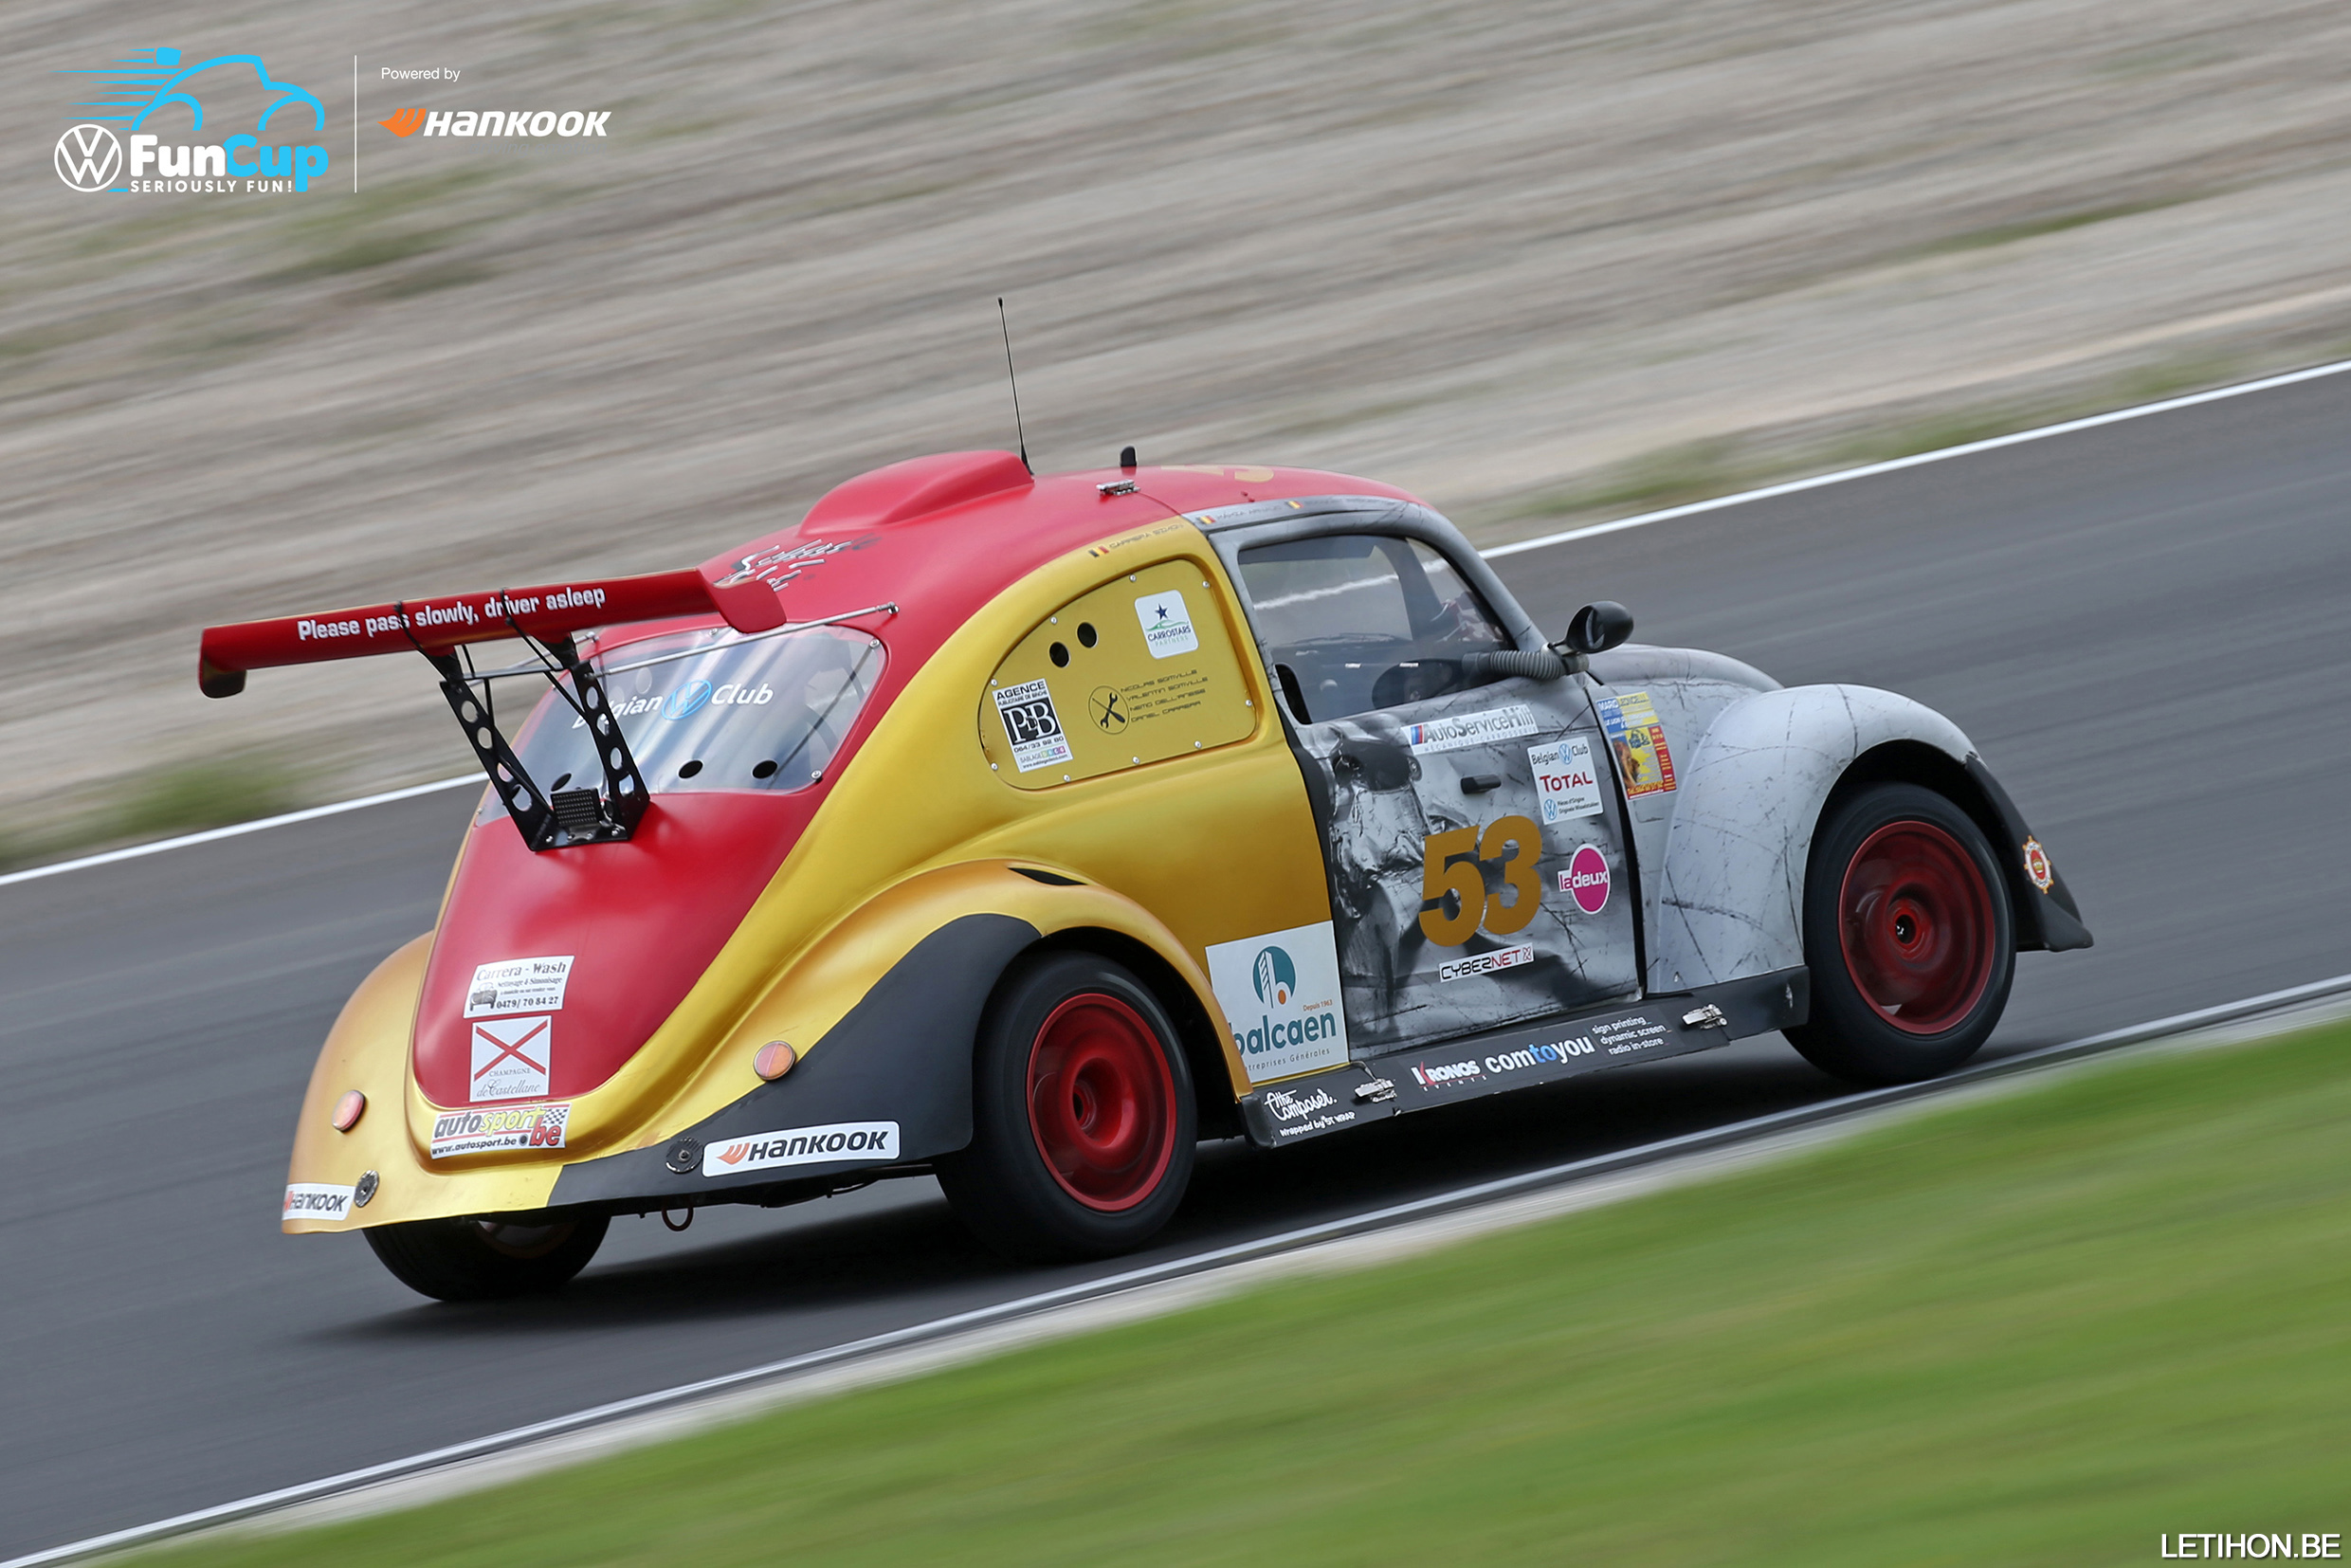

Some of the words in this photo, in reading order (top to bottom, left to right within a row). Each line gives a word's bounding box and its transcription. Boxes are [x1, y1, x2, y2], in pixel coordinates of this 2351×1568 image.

[298, 617, 360, 641] Please
[365, 613, 410, 637] pass
[414, 601, 480, 628] slowly,
[483, 595, 540, 619] driver
[545, 587, 606, 611] asleep
[997, 681, 1046, 701] AGENCE
[572, 695, 664, 729] gian
[711, 683, 774, 705] Club
[1531, 751, 1559, 766] Belgian
[1572, 743, 1589, 757] Club
[1540, 772, 1594, 793] TOTAL
[1418, 814, 1542, 947] 53
[533, 962, 567, 975] Wash
[522, 997, 535, 1007] 70
[535, 996, 547, 1006] 84
[548, 995, 559, 1005] 27
[1592, 1025, 1613, 1035] sign
[1600, 1031, 1638, 1046] dynamic
[1245, 1057, 1286, 1072] treprises
[1290, 1048, 1331, 1063] Générales
[1485, 1035, 1595, 1073] comtoyou
[1608, 1044, 1631, 1055] radio
[488, 1067, 531, 1078] CHAMPAGNE
[434, 1105, 547, 1139] autosport
